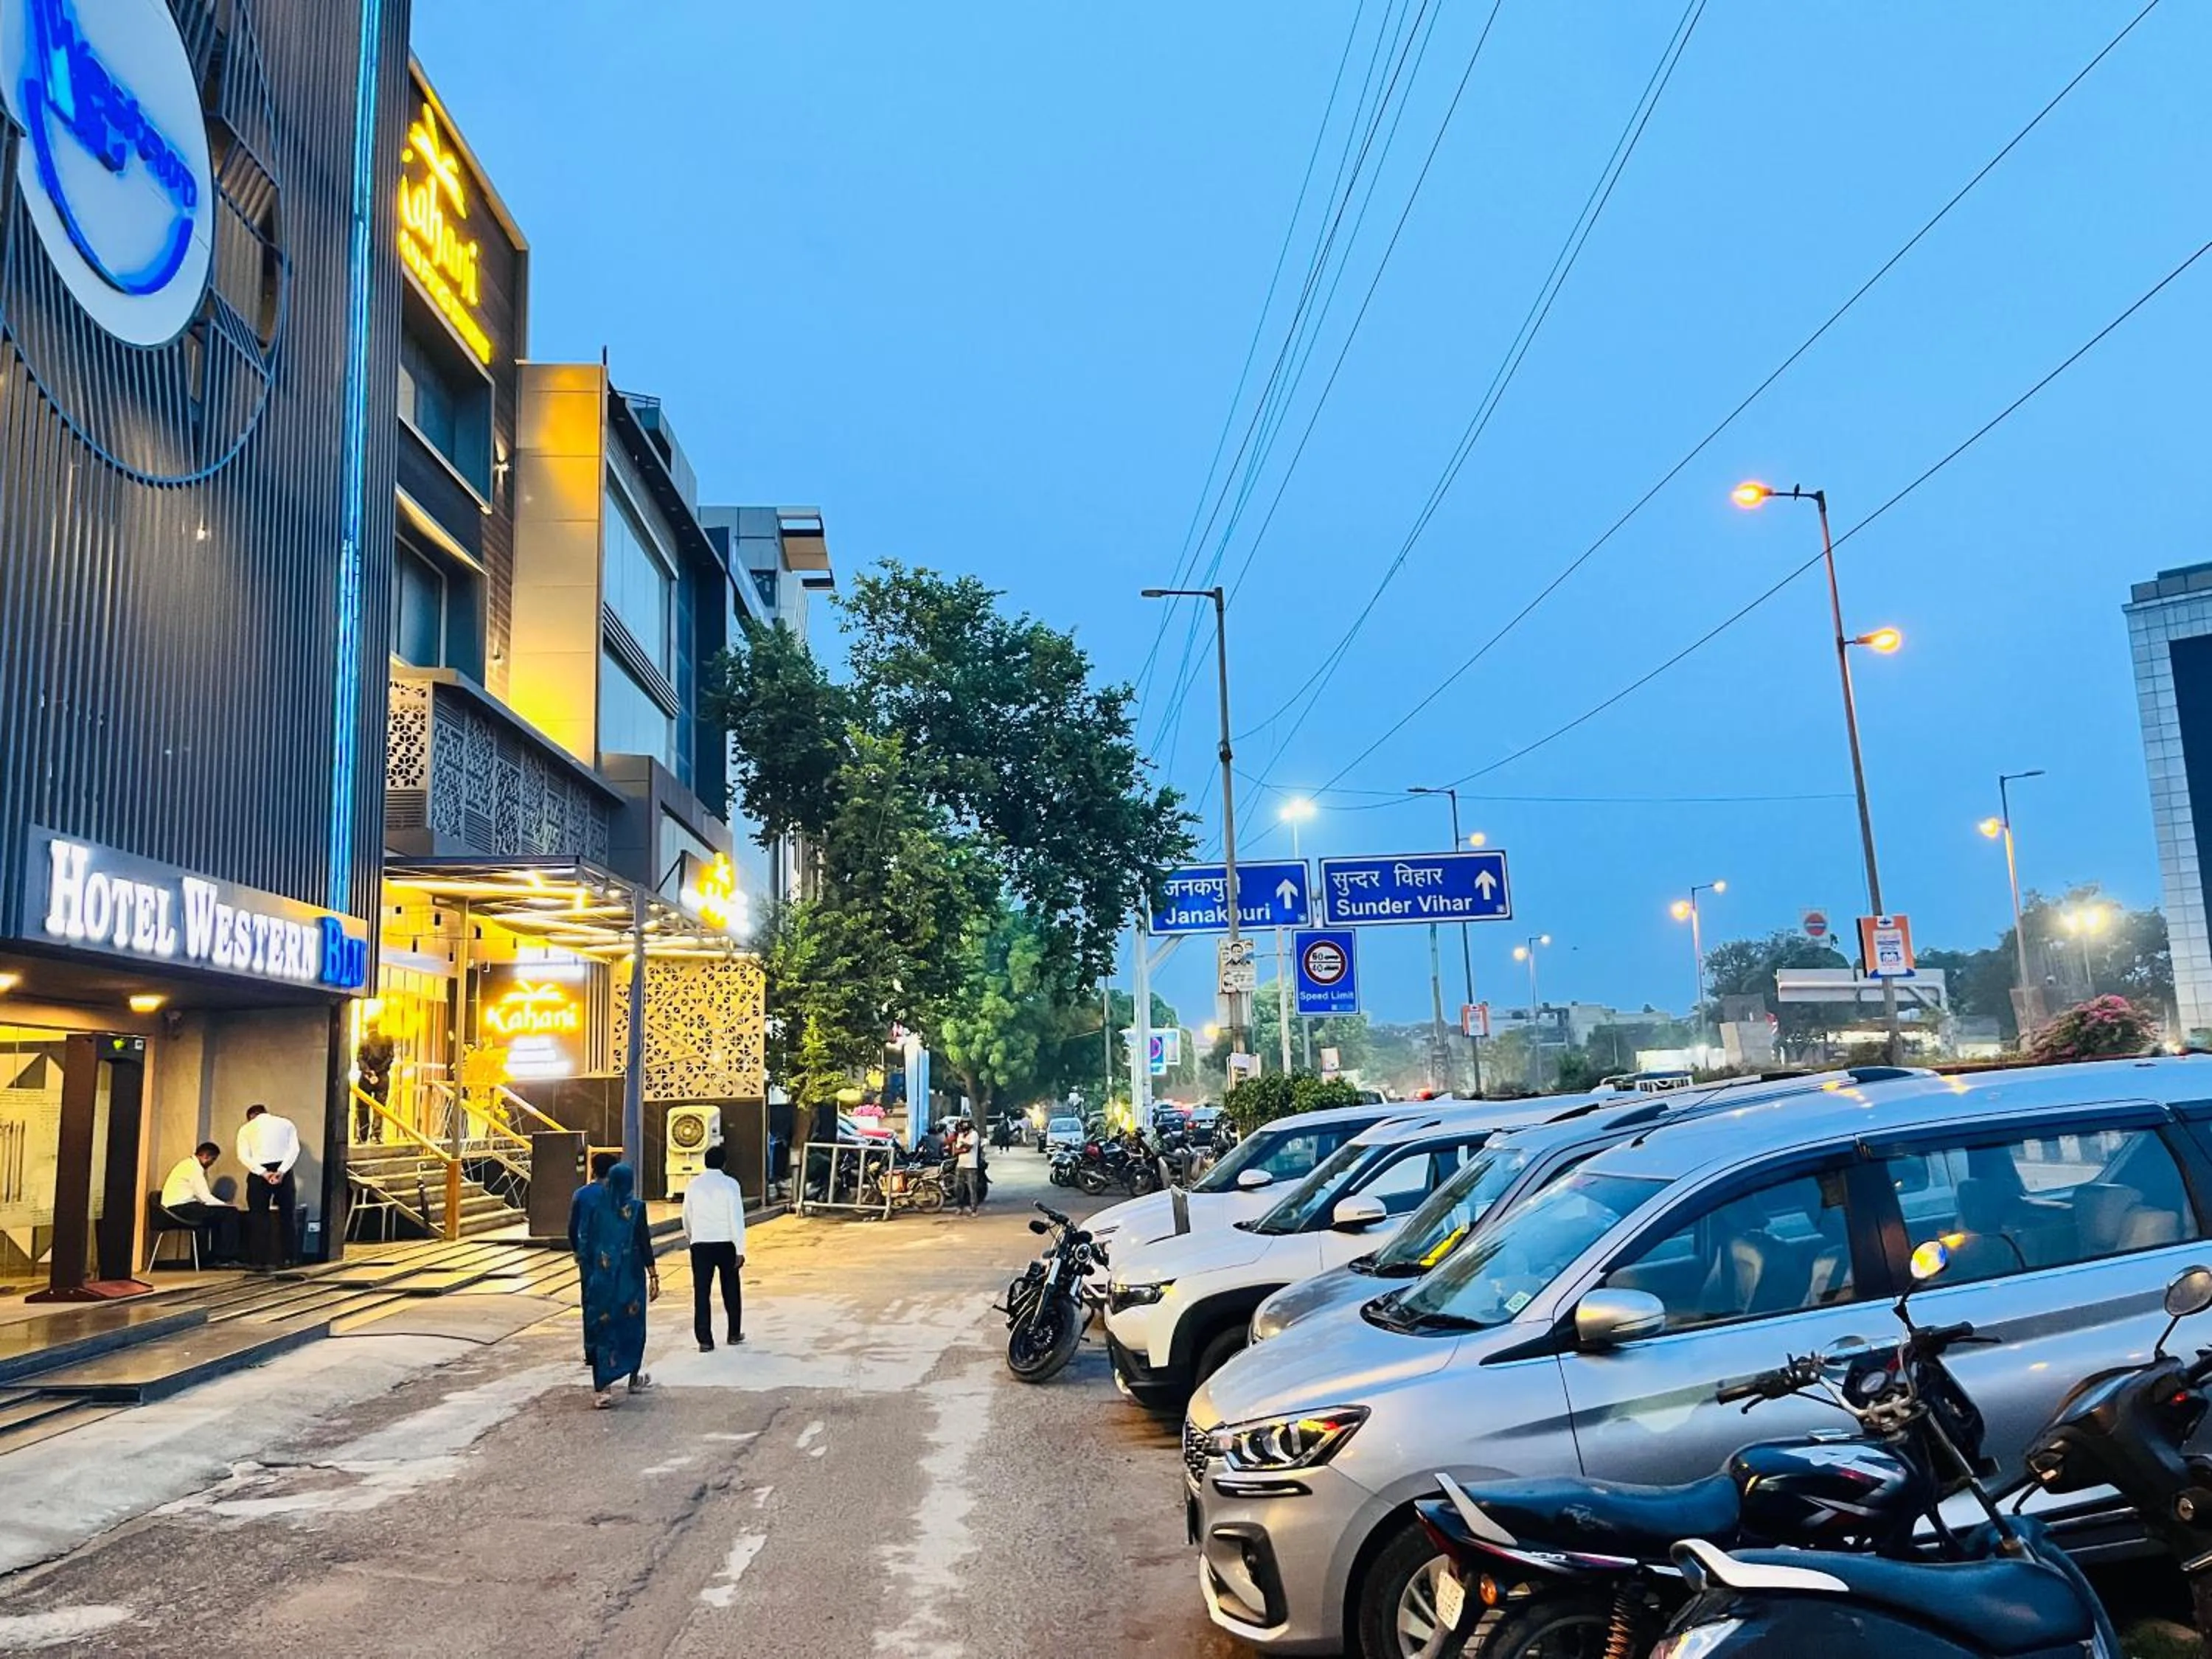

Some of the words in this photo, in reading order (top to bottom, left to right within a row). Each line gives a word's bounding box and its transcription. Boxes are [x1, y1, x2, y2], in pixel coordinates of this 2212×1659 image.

[1330, 871, 1380, 897] सुन्दर
[1394, 863, 1443, 888] विहार
[45, 838, 175, 958] HOTEL
[181, 876, 319, 981] WESTERN
[1337, 900, 1411, 917] Sunder
[1416, 895, 1472, 913] Vihar
[1300, 991, 1328, 1002] Speed
[1331, 990, 1354, 1001] Limit
[486, 1001, 577, 1034] Kahani
